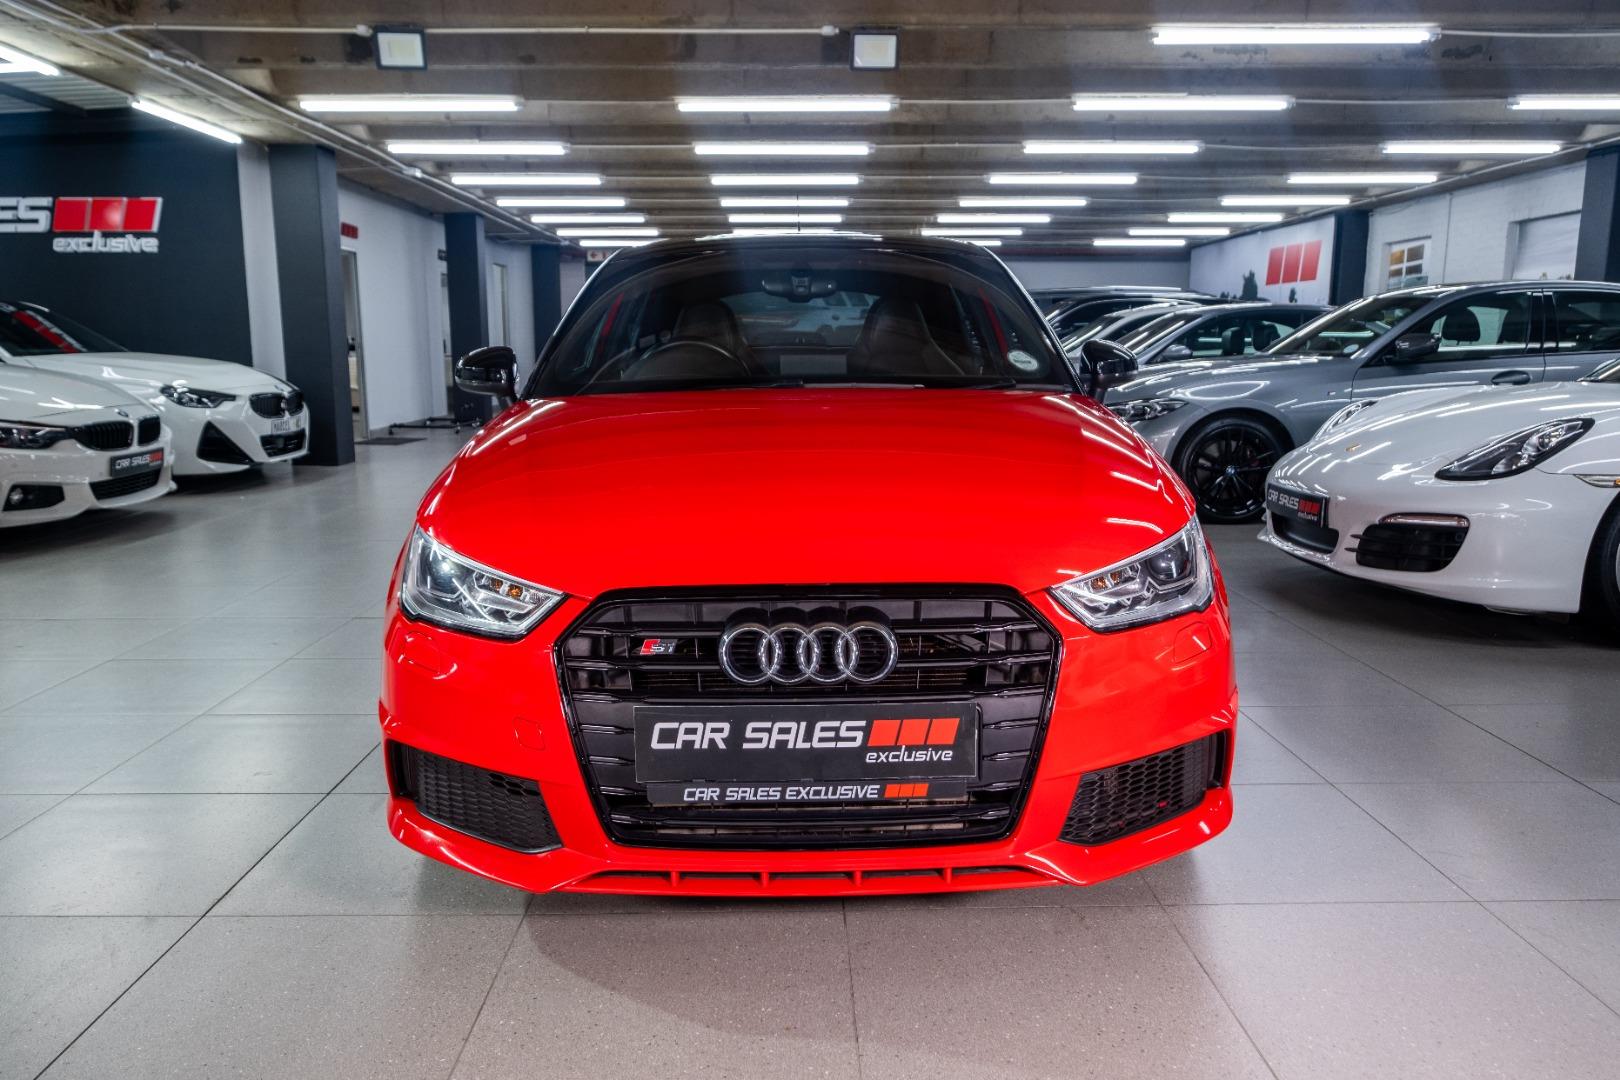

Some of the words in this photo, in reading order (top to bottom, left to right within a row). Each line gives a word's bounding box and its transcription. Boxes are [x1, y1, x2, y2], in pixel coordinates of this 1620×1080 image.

[52, 229, 160, 253] exclusive
[1267, 489, 1278, 502] CAR
[1278, 493, 1299, 510] SALES
[650, 721, 731, 750] CAR
[742, 720, 867, 749] SALES
[865, 745, 954, 763] exclusive
[683, 787, 721, 801] CAR
[725, 786, 781, 801] SALES
[785, 784, 880, 800] EXCLUSIVE
